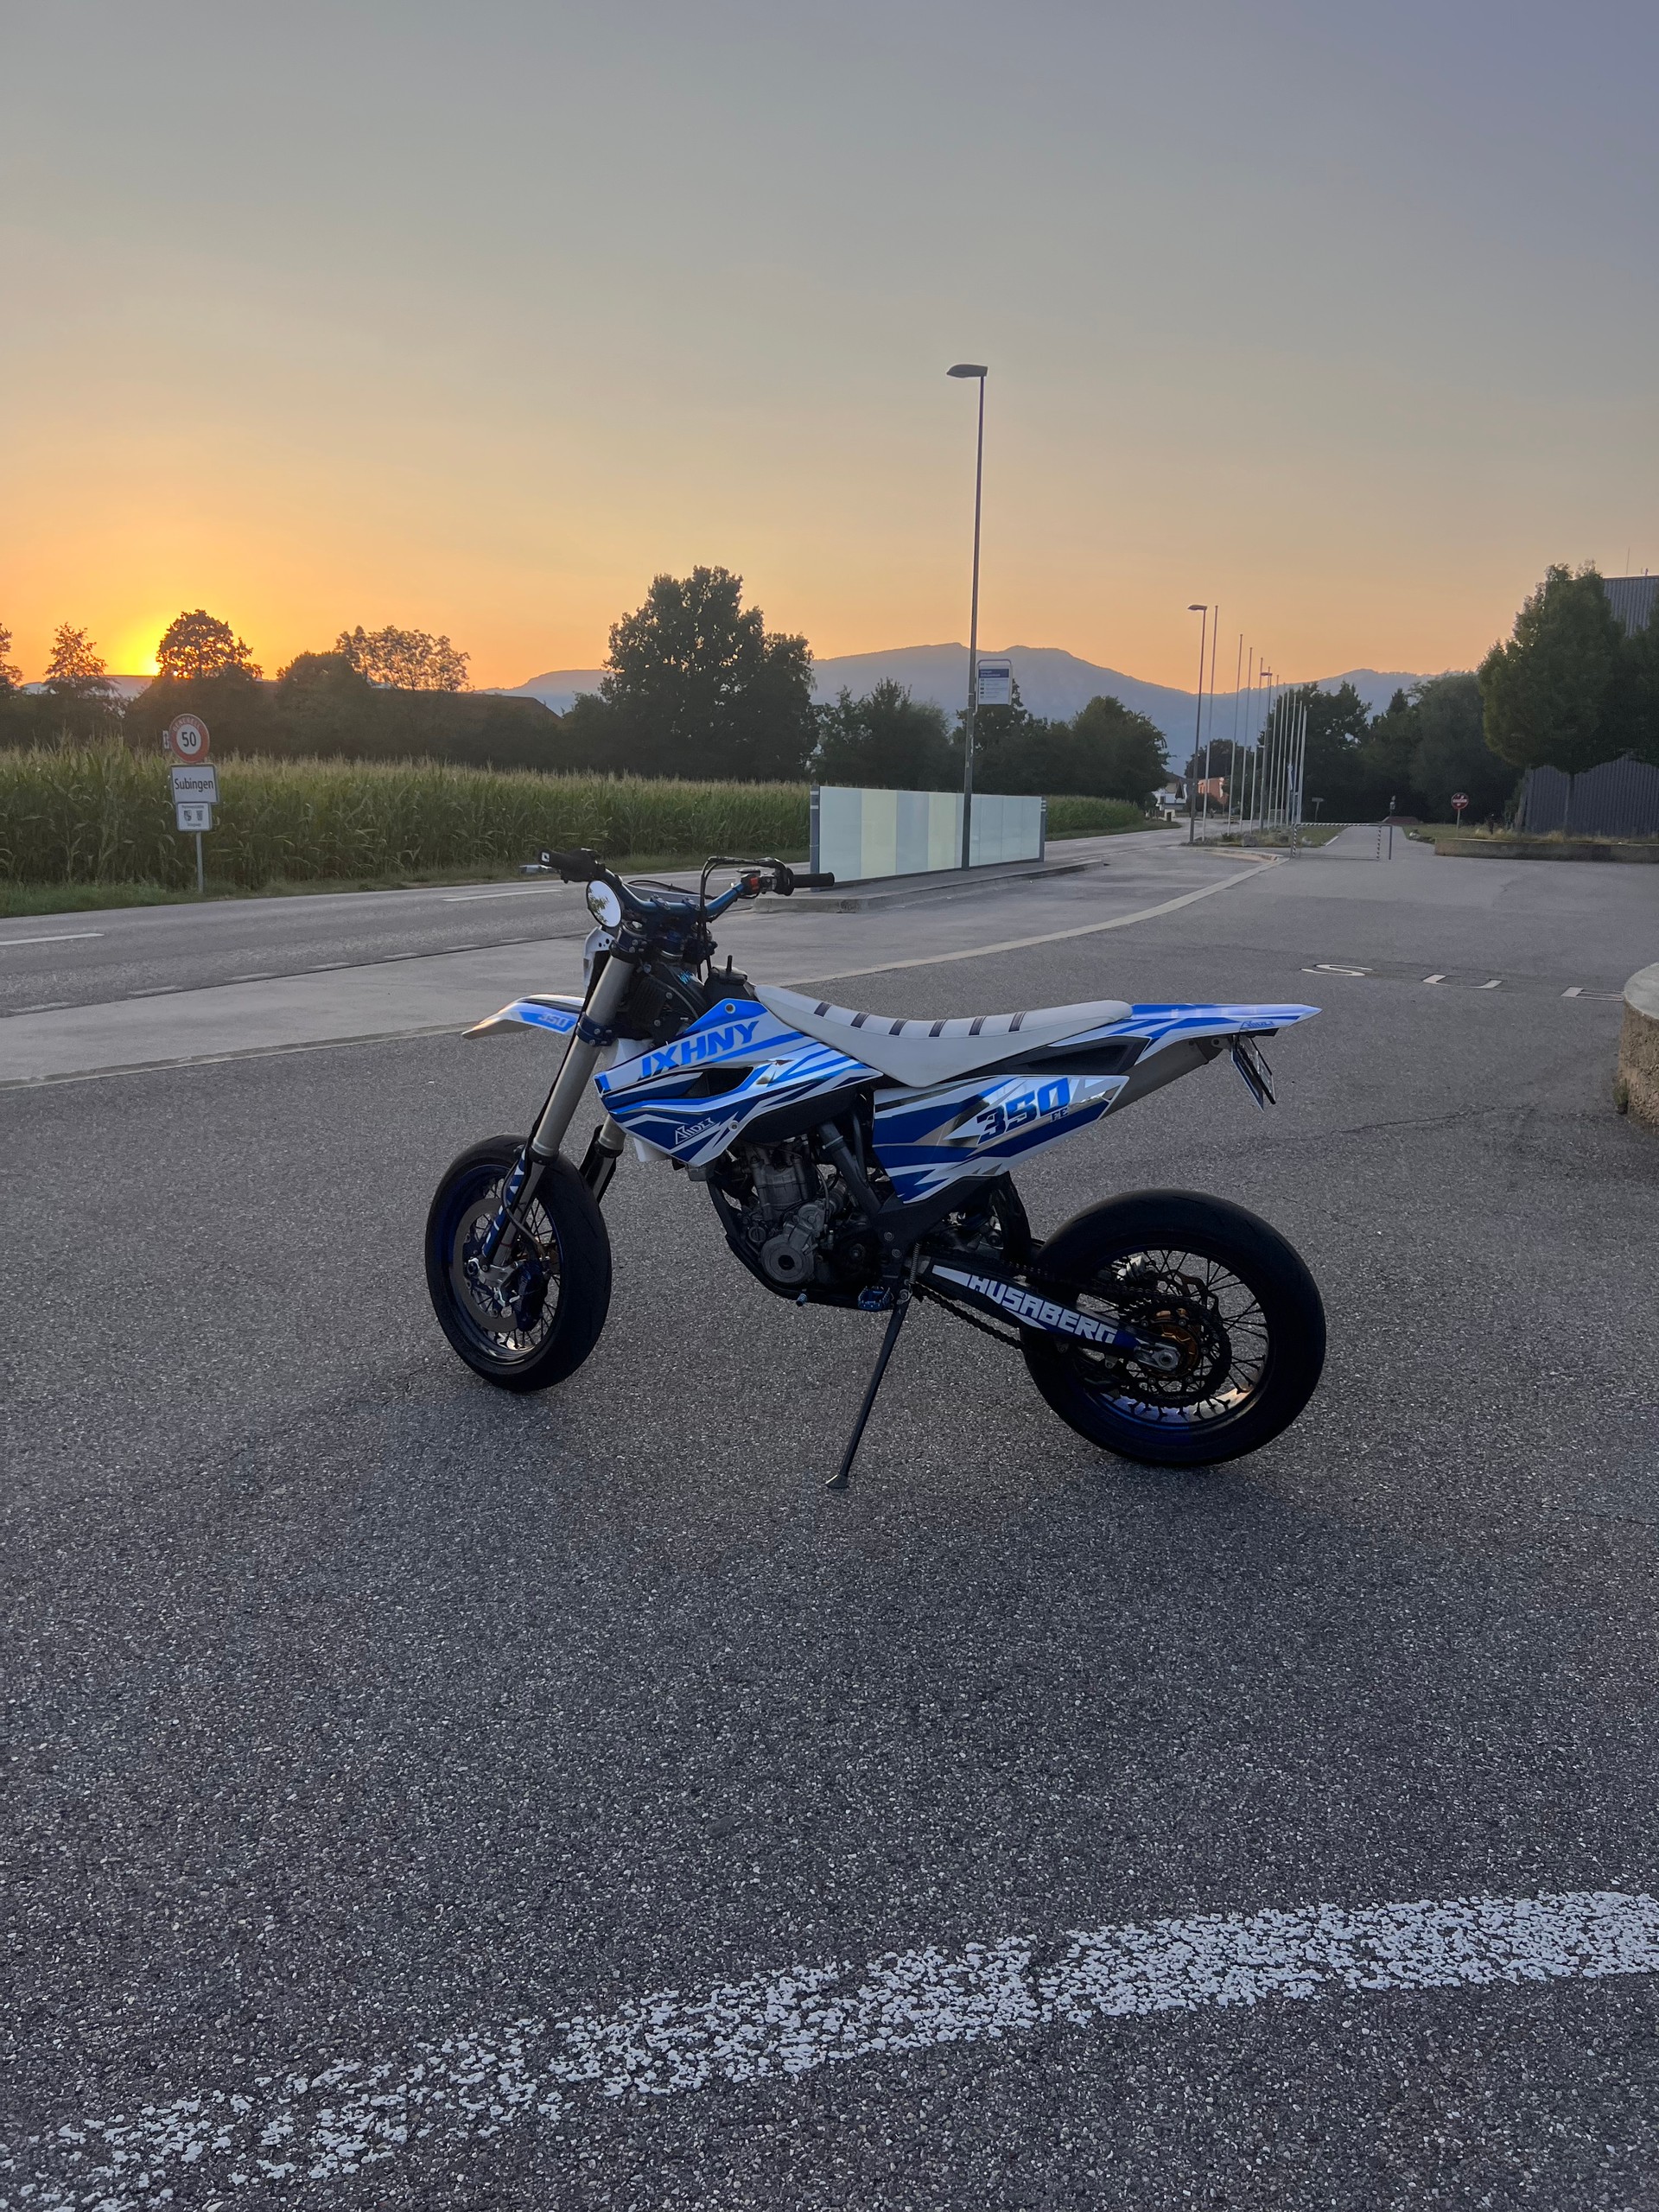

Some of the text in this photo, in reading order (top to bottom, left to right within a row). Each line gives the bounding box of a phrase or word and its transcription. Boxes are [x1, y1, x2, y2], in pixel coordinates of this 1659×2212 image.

[181, 731, 197, 747] 50
[175, 778, 214, 792] Subingen
[976, 1077, 1071, 1146] 350
[1051, 1107, 1069, 1122] FE
[968, 1274, 1118, 1344] HUSABERG
